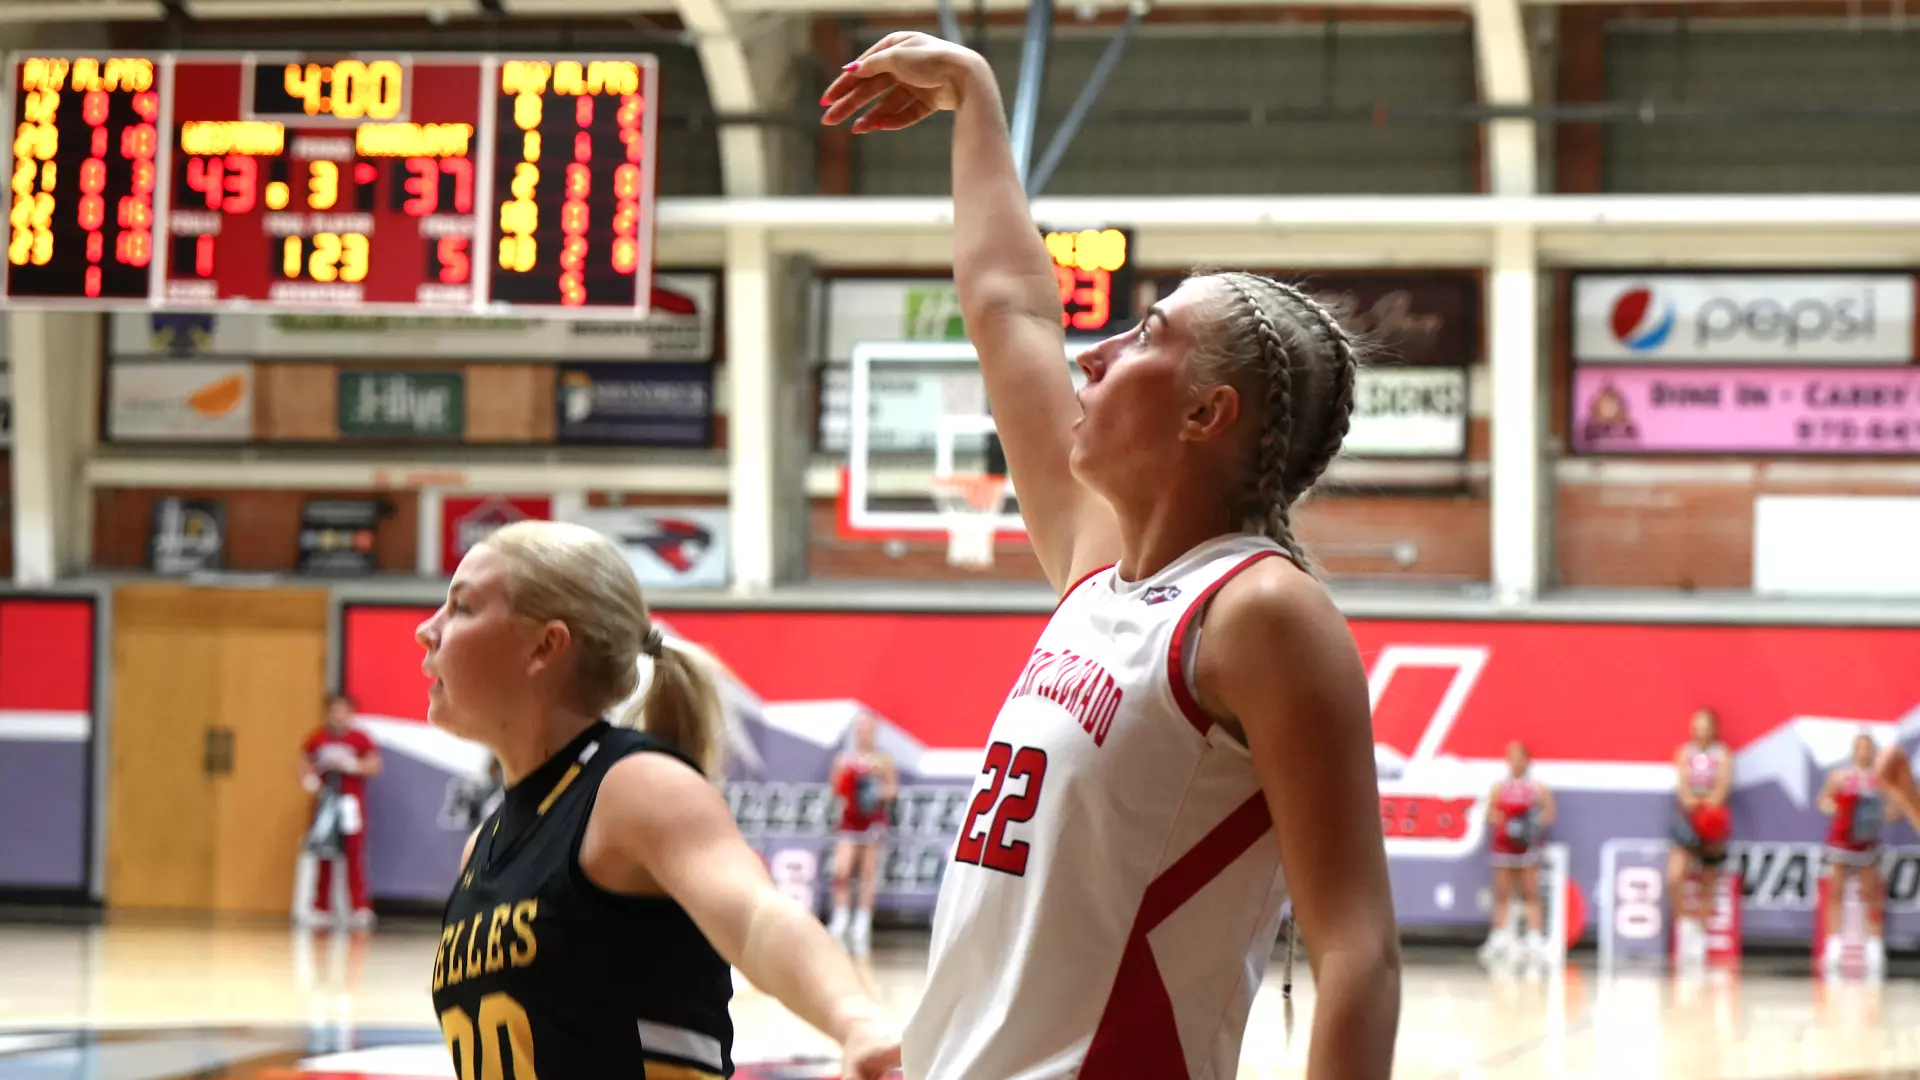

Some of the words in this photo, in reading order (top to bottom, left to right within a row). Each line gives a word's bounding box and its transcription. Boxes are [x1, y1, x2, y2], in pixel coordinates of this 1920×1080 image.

[285, 60, 402, 120] 4:00
[187, 154, 258, 214] 43
[308, 159, 338, 210] 3
[404, 156, 473, 216] 37
[195, 233, 214, 277] 1
[436, 234, 469, 284] 5
[1694, 286, 1877, 352] pepsi
[954, 741, 1048, 878] 22
